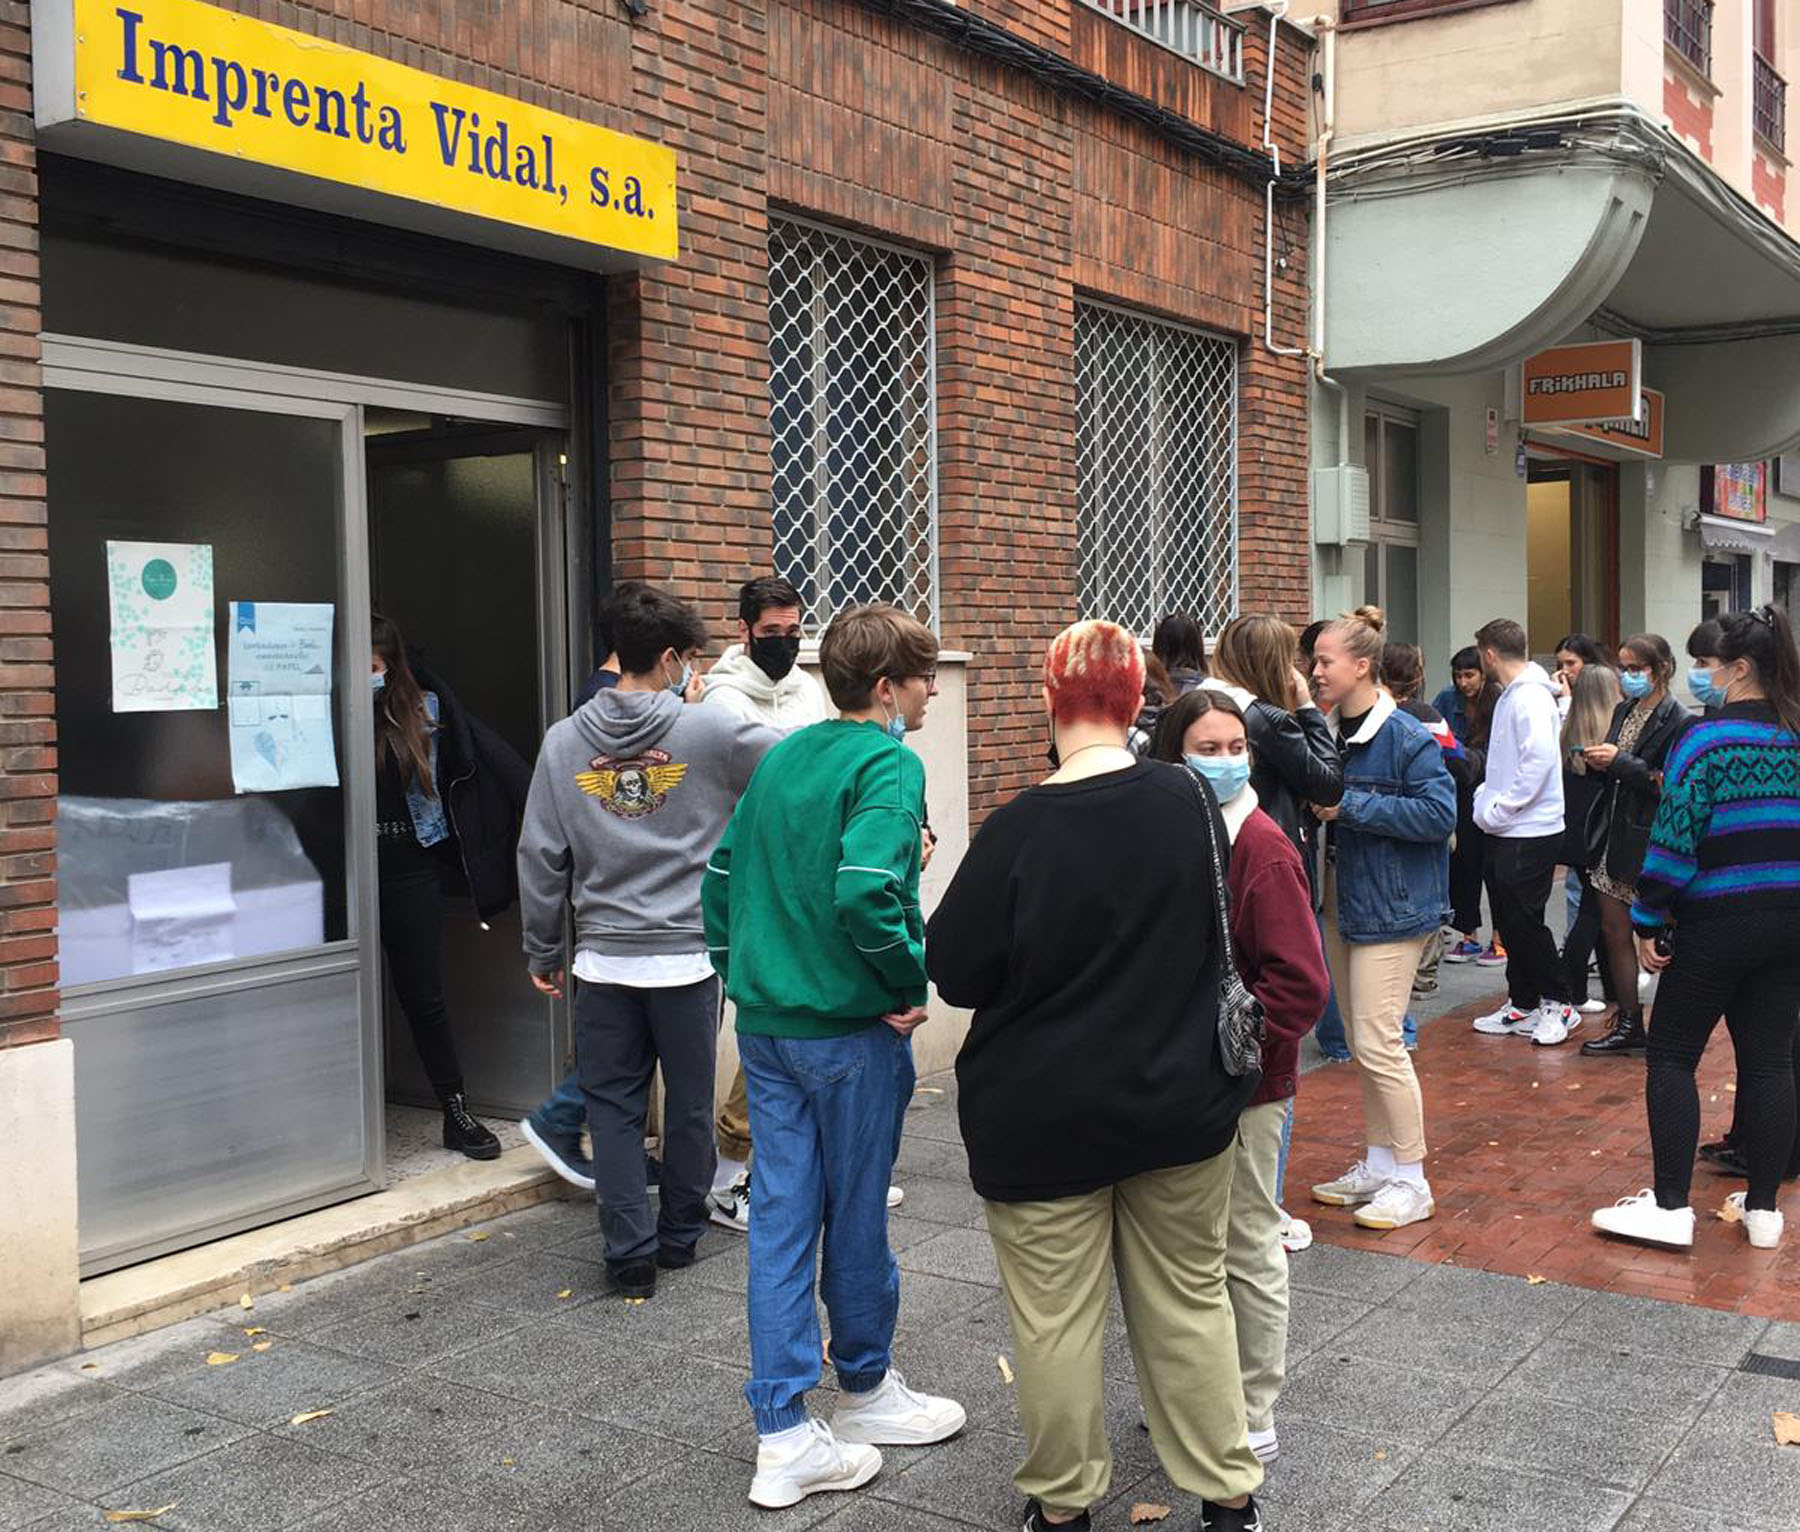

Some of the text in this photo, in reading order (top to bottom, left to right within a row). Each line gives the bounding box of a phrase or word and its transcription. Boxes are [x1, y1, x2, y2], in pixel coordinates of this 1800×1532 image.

[117, 8, 656, 220] Imprenta Vidal, s.a.
